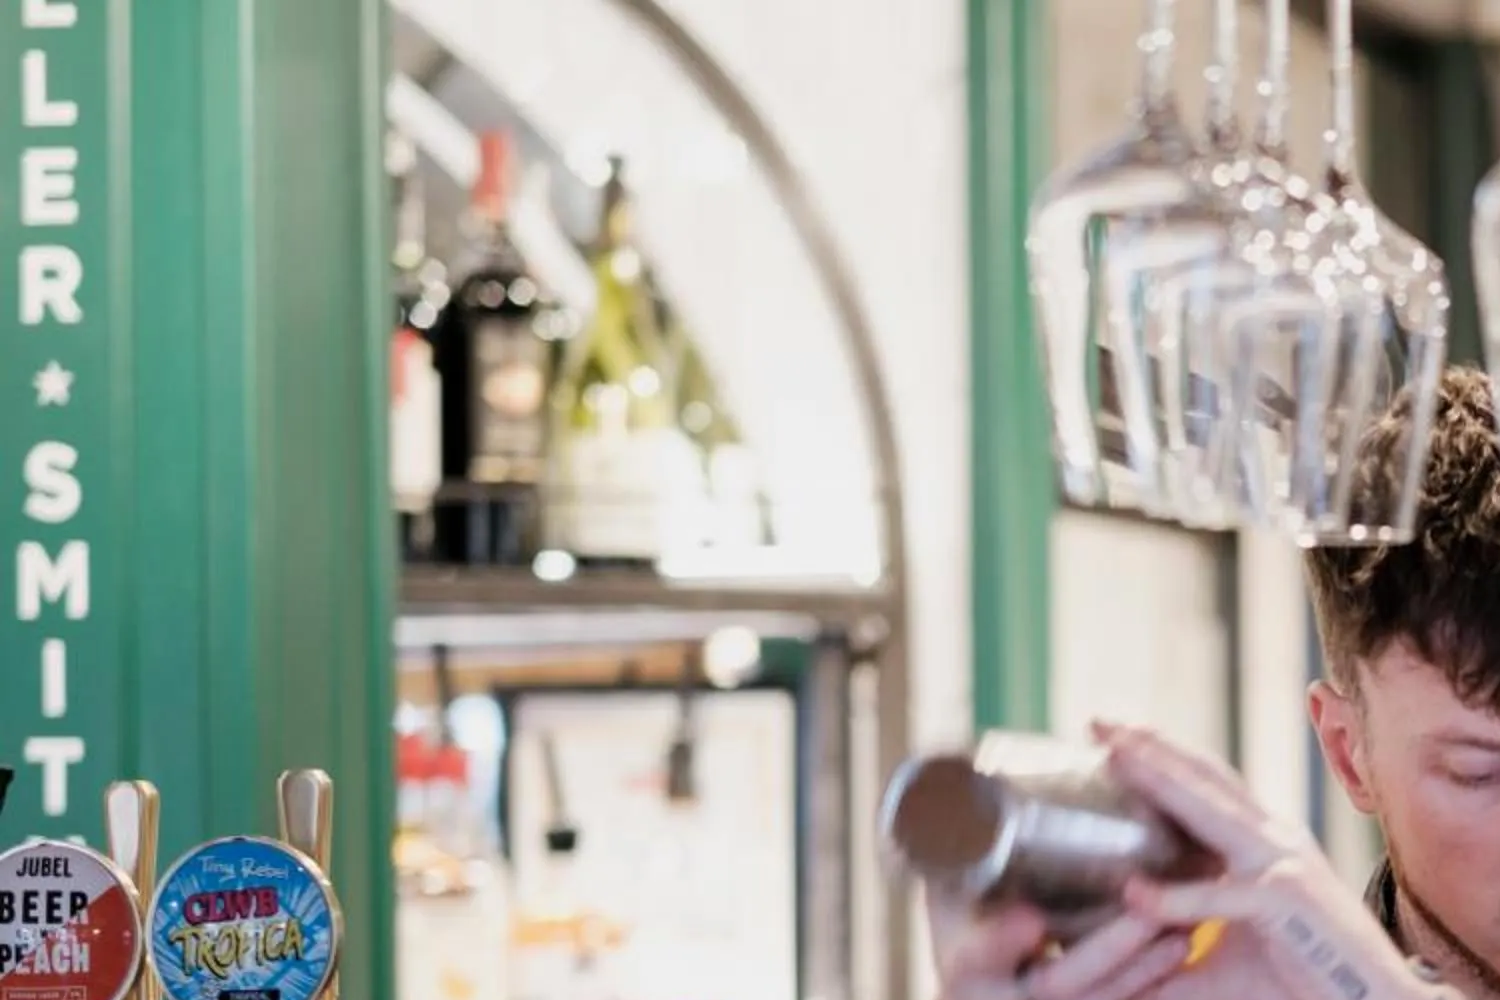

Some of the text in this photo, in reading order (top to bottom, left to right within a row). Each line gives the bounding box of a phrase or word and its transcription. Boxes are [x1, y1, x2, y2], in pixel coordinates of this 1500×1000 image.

[16, 441, 90, 847] SMIT
[16, 857, 72, 877] JUBEL
[198, 855, 289, 883] Tiny Rebel
[0, 890, 89, 925] BEER
[183, 886, 279, 925] CLWB
[0, 943, 90, 975] PEACH
[169, 917, 304, 979] TROPICA
